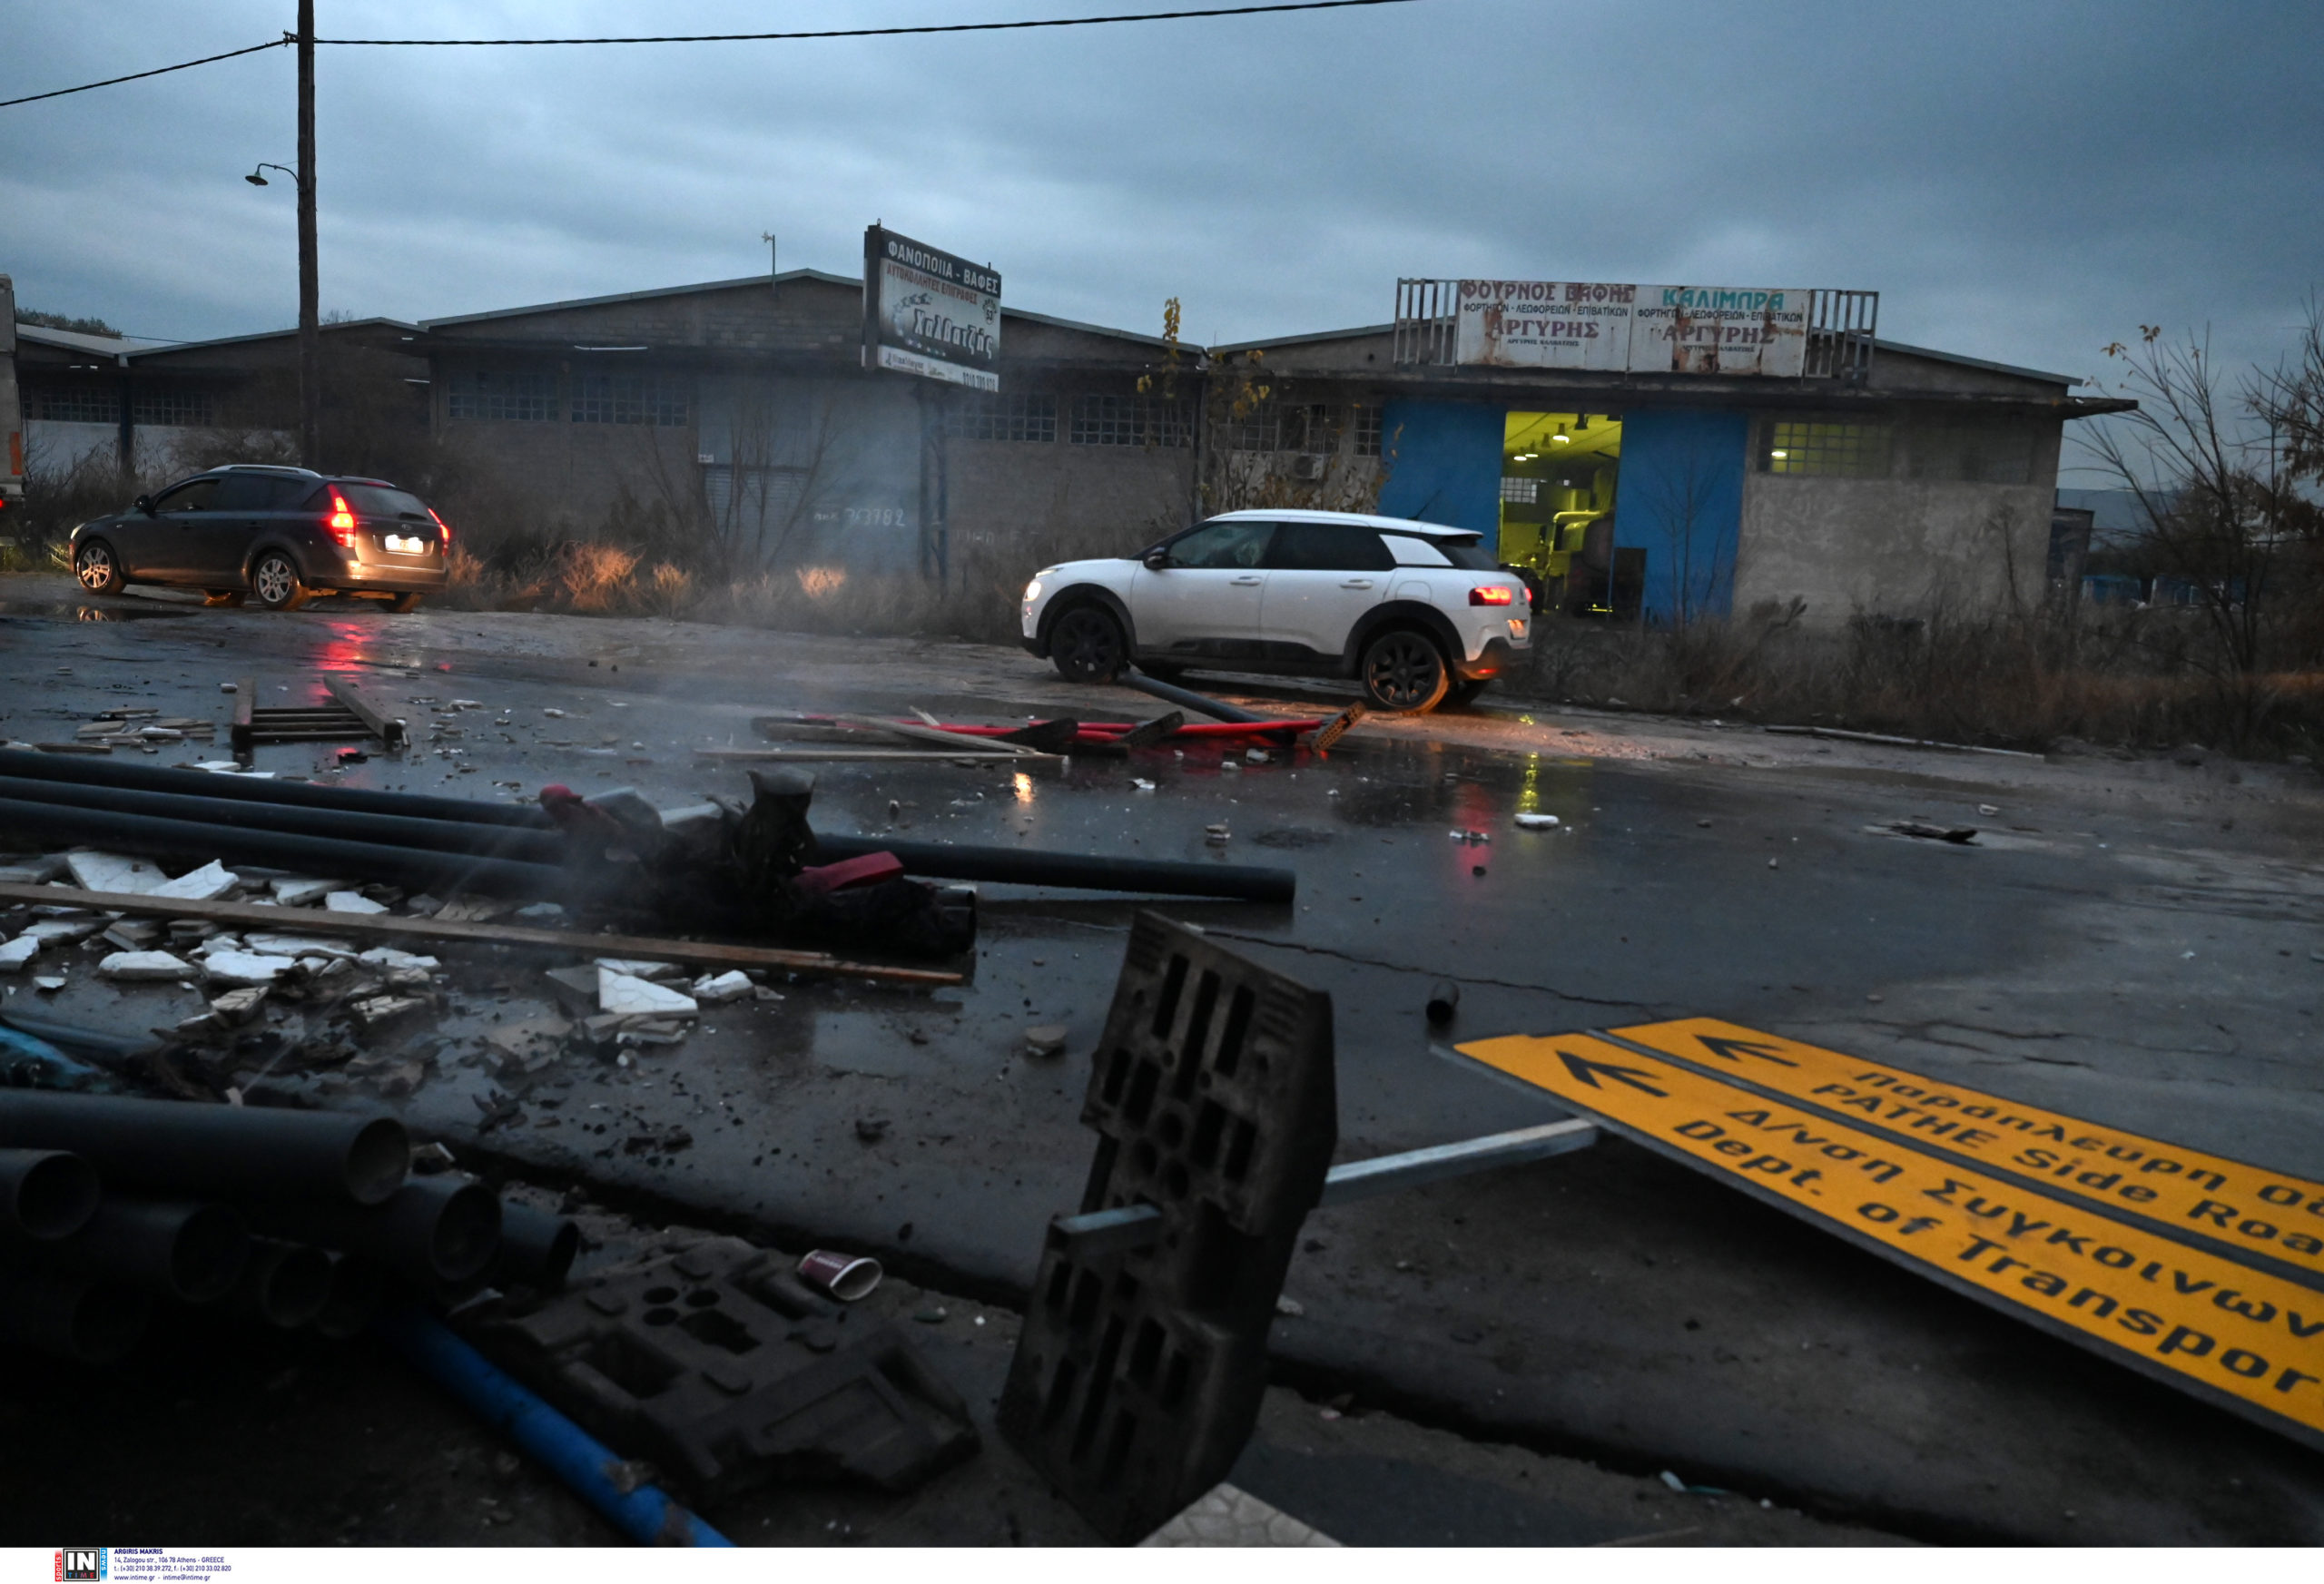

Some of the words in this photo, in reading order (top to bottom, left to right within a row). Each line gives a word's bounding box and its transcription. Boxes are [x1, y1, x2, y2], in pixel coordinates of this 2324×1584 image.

[963, 269, 999, 295] ΒΑΦΕΣ
[1460, 281, 1556, 300] ΦΟΥΡΝΟΣ
[1565, 284, 1635, 303] ΒΑΦΗΣ
[1515, 303, 1571, 315] ΛΕΩΦΟΡΕΙΩΝ
[1577, 306, 1629, 317] ΕΠΙΒΑΤΙΚΩΝ
[1662, 289, 1784, 310] ΚΑΛΙΜΠΡΑ
[1689, 310, 1745, 320] ΛΕΩΦΟΡΕΙΩΝ
[1492, 319, 1600, 339] ΑΡΓΥΡΗΣ
[1662, 325, 1776, 344] ΑΡΓΥΡΗΣ
[1726, 1109, 1905, 1184] Δ/νση
[1811, 1083, 2000, 1149] PATHE
[2012, 1146, 2160, 1203] Side
[1673, 1119, 1823, 1196] Dept.
[1857, 1202, 1944, 1235] of
[1957, 1233, 2324, 1394] Transpor
